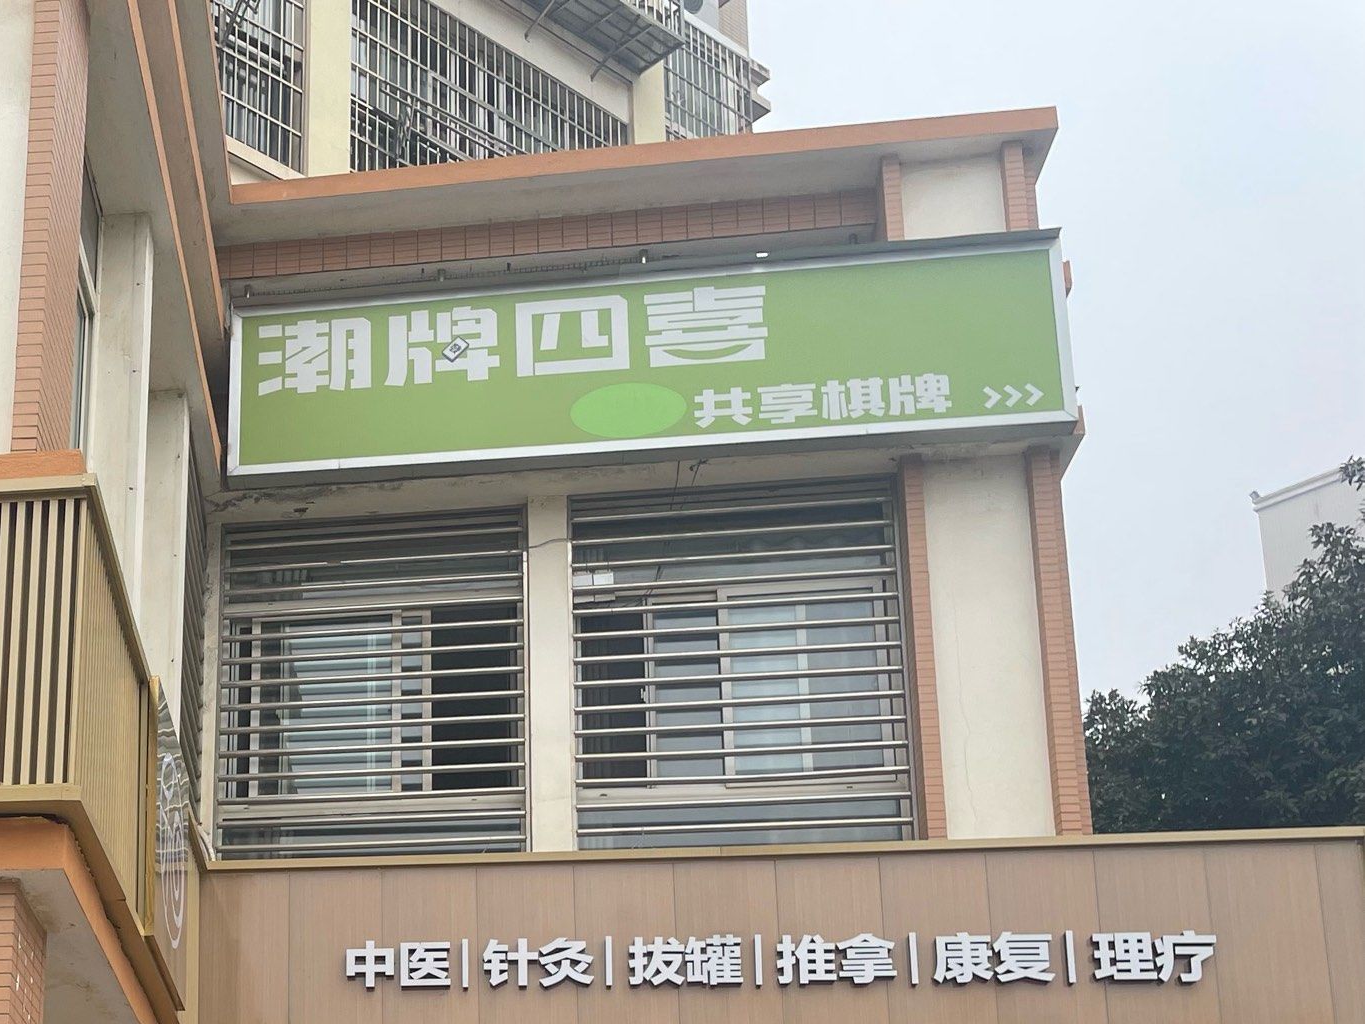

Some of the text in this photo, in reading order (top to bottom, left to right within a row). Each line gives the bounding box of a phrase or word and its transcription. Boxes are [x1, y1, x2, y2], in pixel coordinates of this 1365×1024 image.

[257, 285, 769, 396] 潮牌四喜
[693, 372, 953, 428] 共享棋牌
